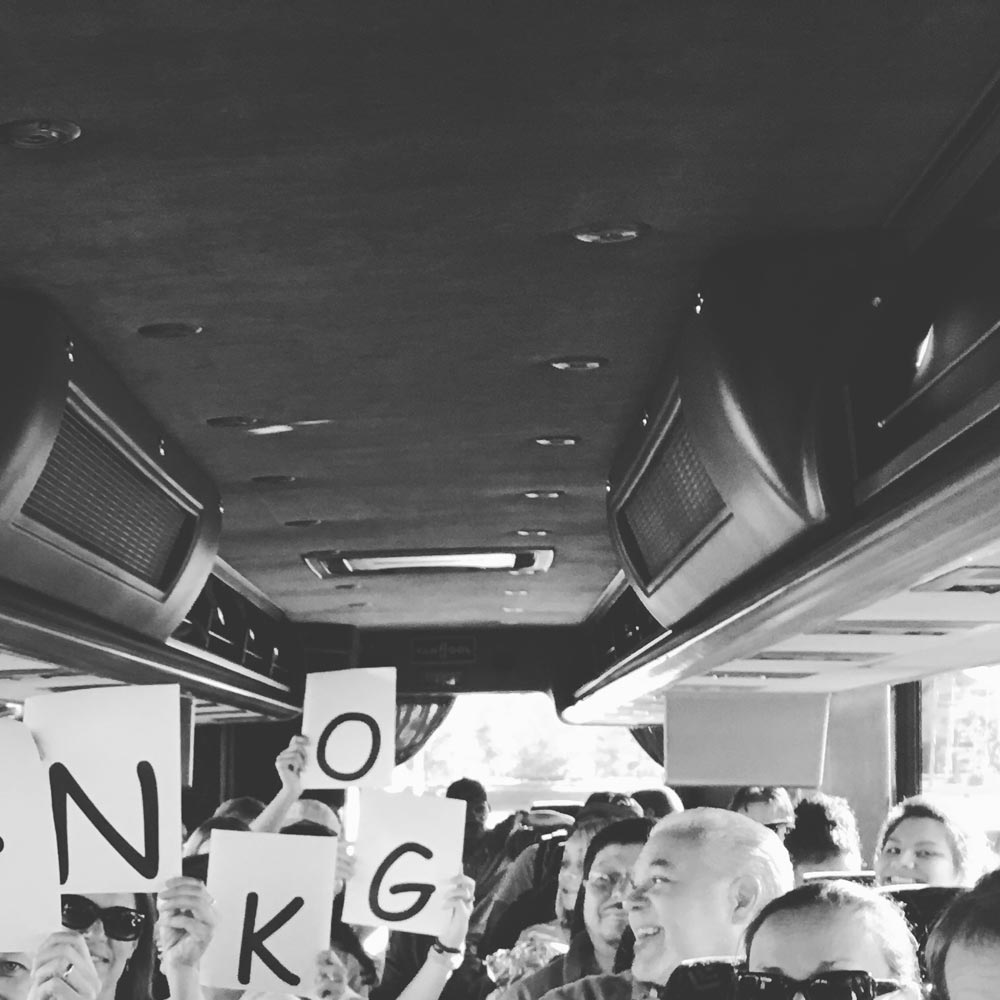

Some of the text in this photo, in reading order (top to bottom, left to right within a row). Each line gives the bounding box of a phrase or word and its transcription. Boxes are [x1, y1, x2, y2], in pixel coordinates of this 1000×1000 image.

[316, 712, 381, 781] O
[48, 760, 160, 885] N
[368, 842, 436, 922] G
[237, 891, 305, 987] K
